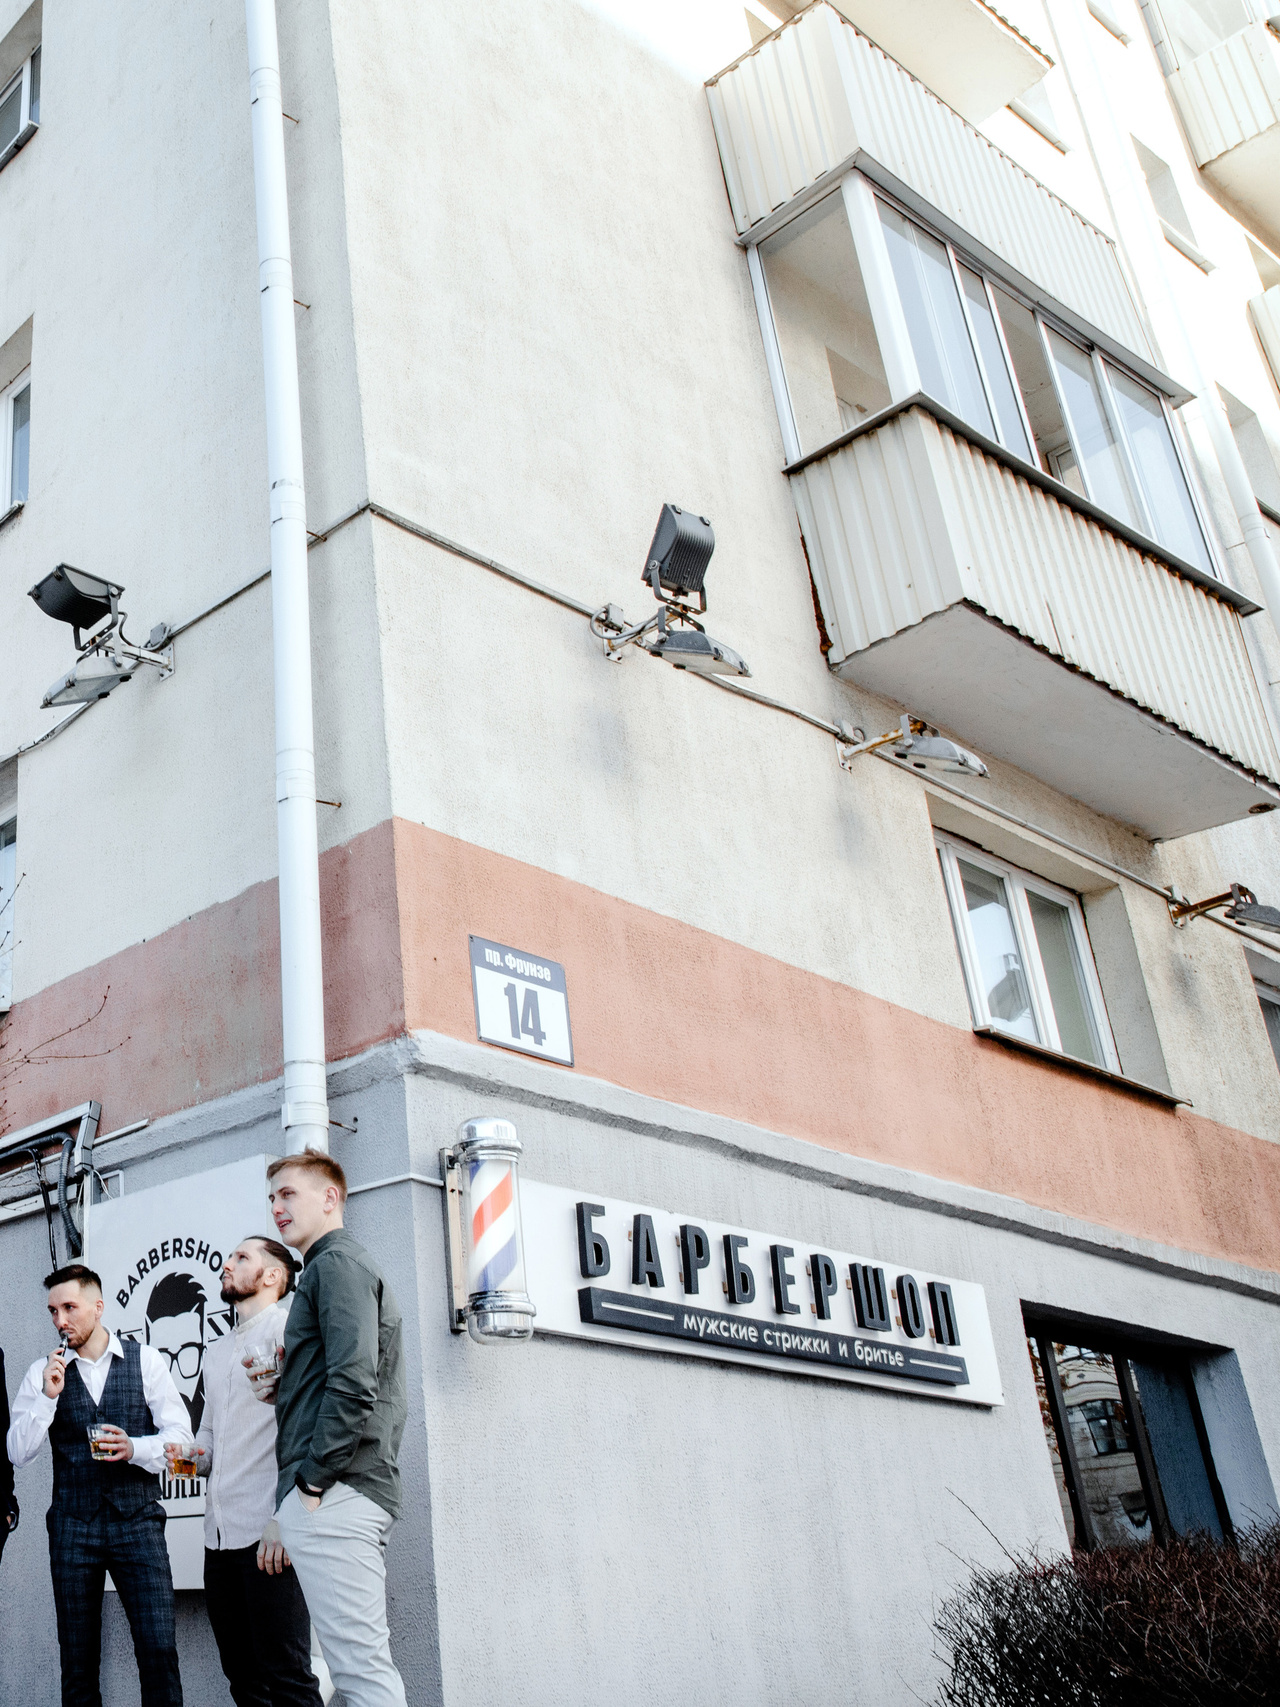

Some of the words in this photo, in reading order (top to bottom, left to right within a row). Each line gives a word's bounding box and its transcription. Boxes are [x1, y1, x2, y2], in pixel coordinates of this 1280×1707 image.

[484, 947, 504, 967] пр.
[503, 982, 547, 1047] 14
[116, 1237, 225, 1309] BARBERSHO
[575, 1201, 961, 1346] БАРБЕРШОП
[683, 1313, 759, 1343] мужские
[763, 1328, 830, 1355] стрижки
[838, 1343, 849, 1358] и
[854, 1339, 905, 1367] бритье
